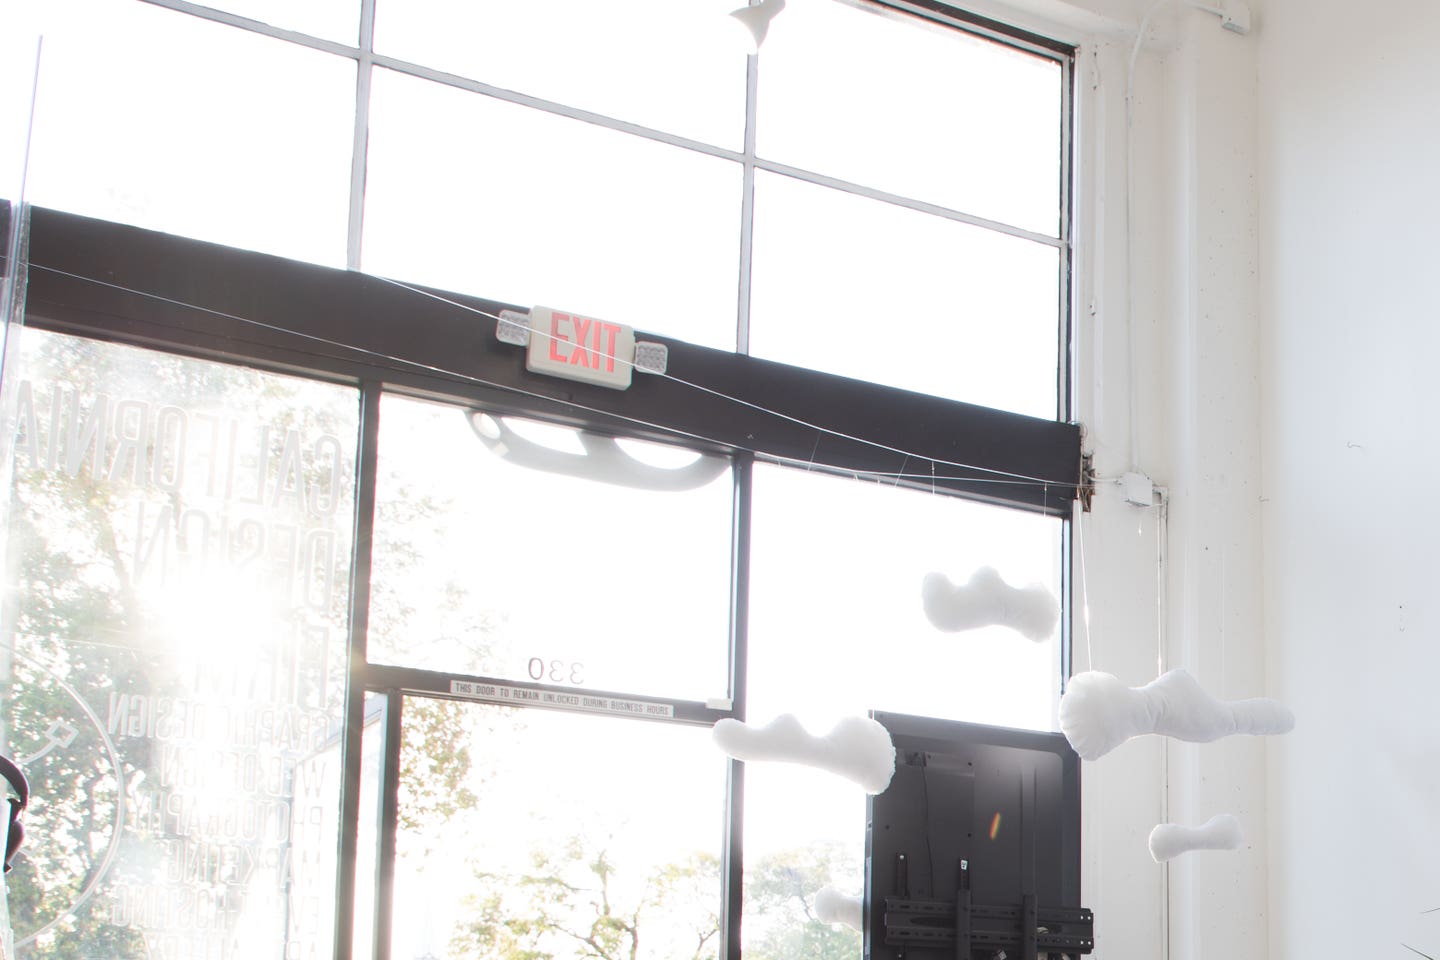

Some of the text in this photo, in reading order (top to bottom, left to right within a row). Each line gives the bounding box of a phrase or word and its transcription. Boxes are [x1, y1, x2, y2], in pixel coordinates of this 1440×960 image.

[549, 312, 622, 373] EXIT
[456, 683, 669, 715] THIS DOOR TO REMAIN UNLOCKED DURING BUSINESS HOURS
